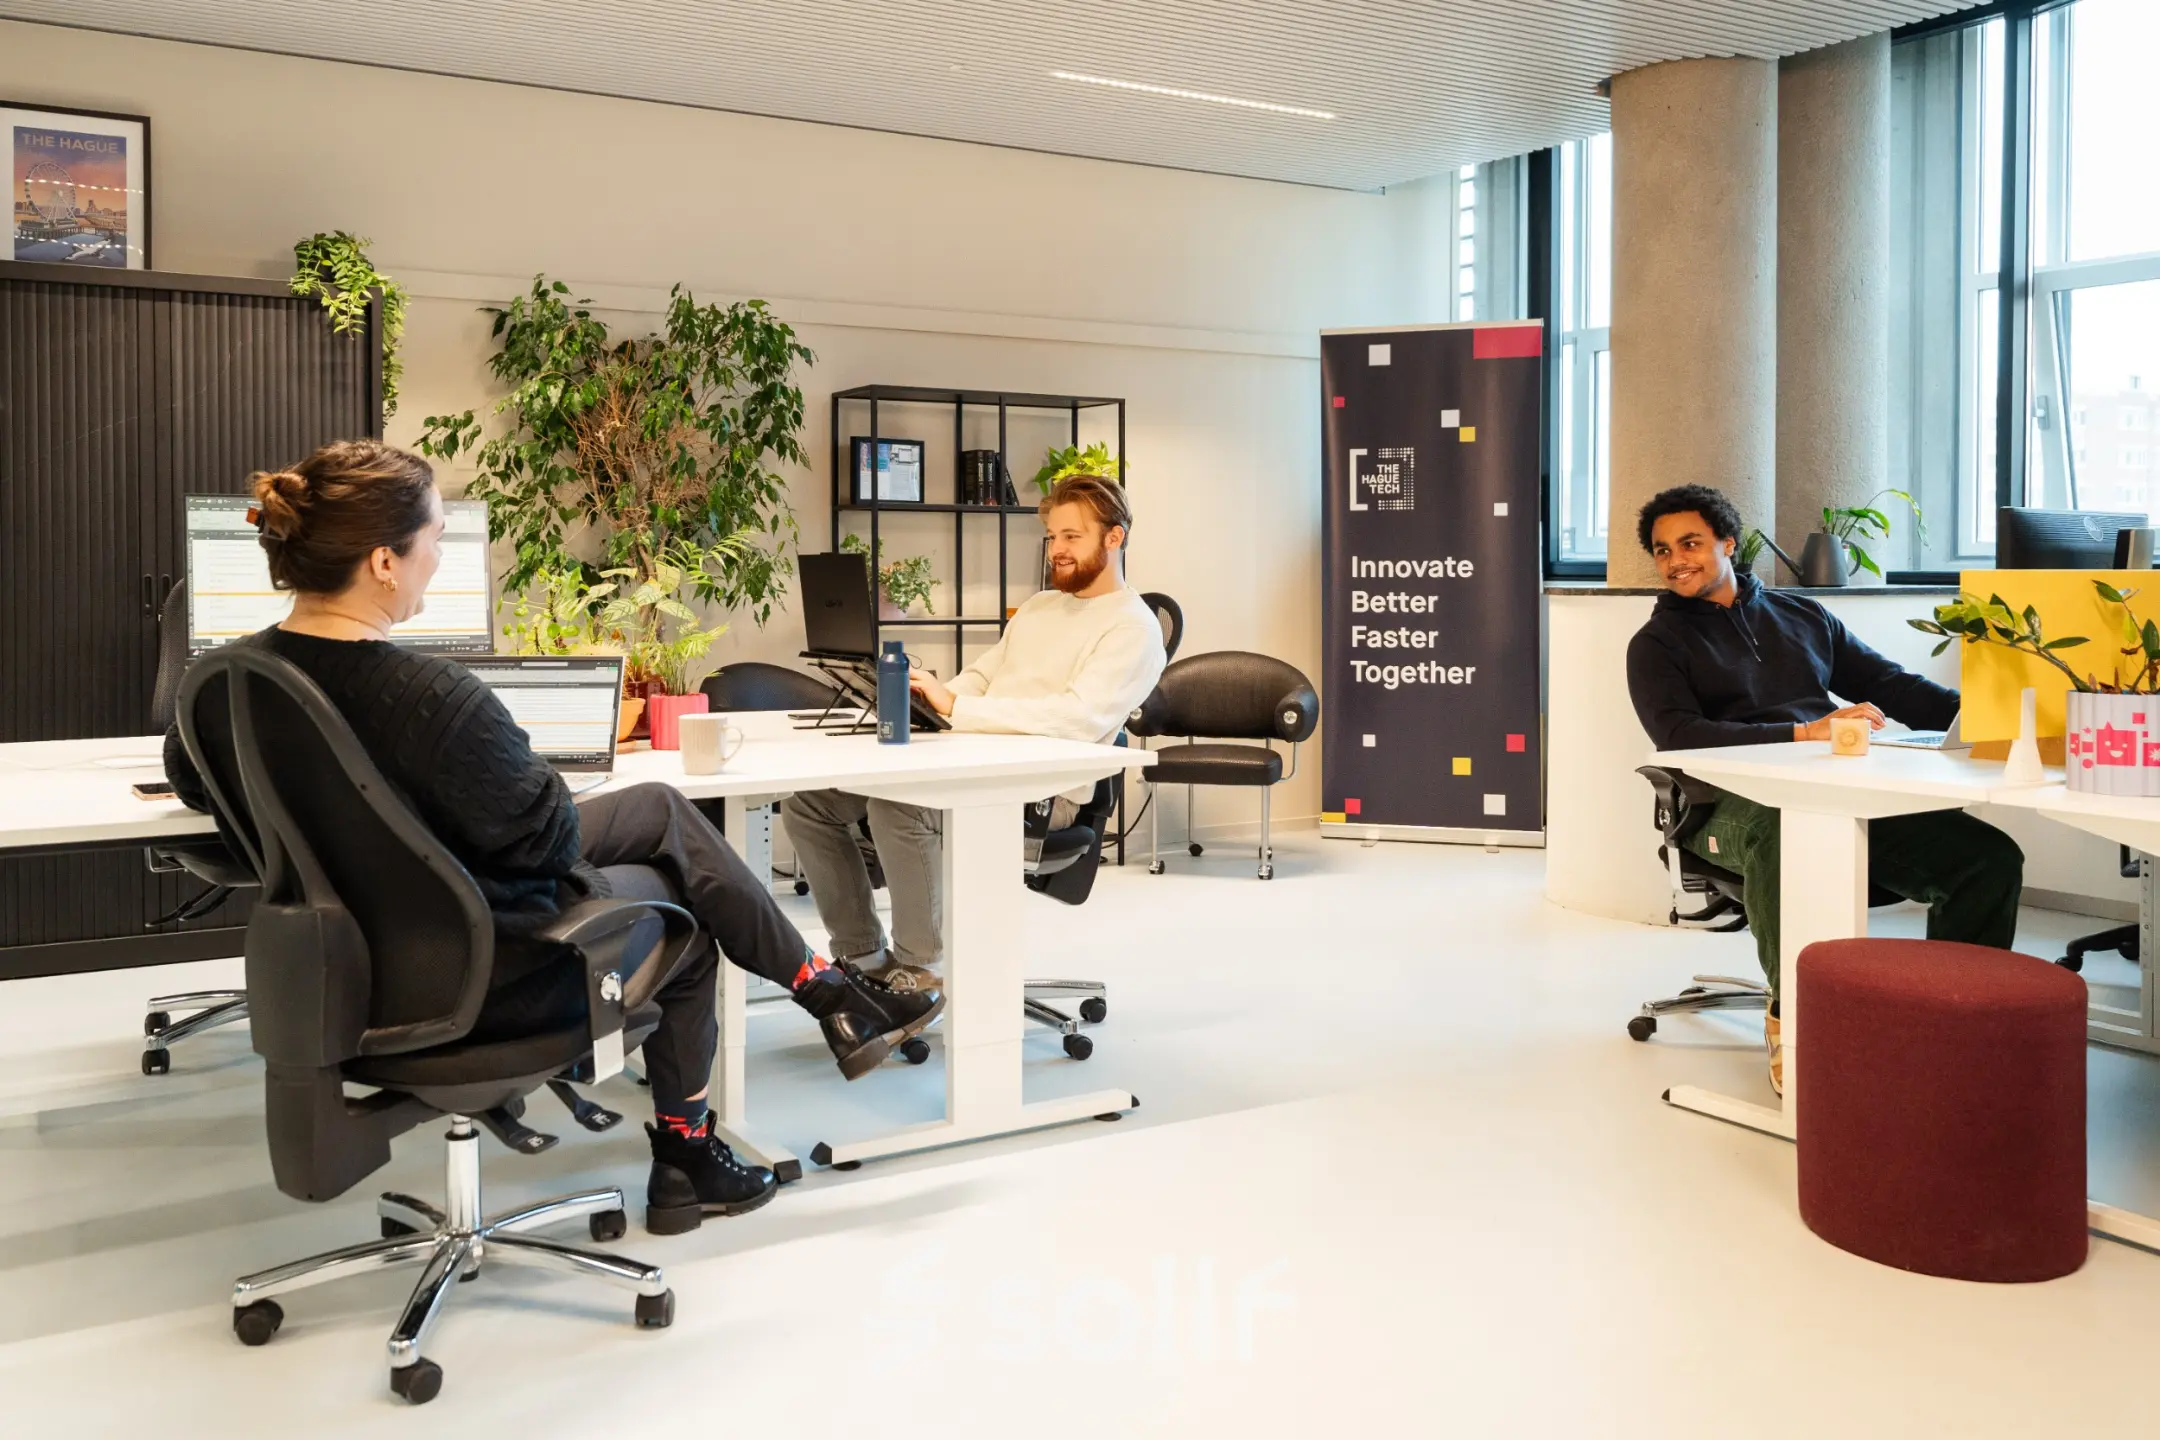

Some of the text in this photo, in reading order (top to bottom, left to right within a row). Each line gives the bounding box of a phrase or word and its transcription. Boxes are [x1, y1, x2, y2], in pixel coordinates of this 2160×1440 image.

[23, 133, 118, 153] THE HAGUE
[1361, 474, 1400, 484] HAGUE
[1377, 464, 1400, 474] THE
[1369, 484, 1400, 494] TECH
[1351, 555, 1474, 579] Innovate
[1351, 590, 1438, 613] Better
[1351, 625, 1438, 648] Faster
[1350, 660, 1476, 690] Together
